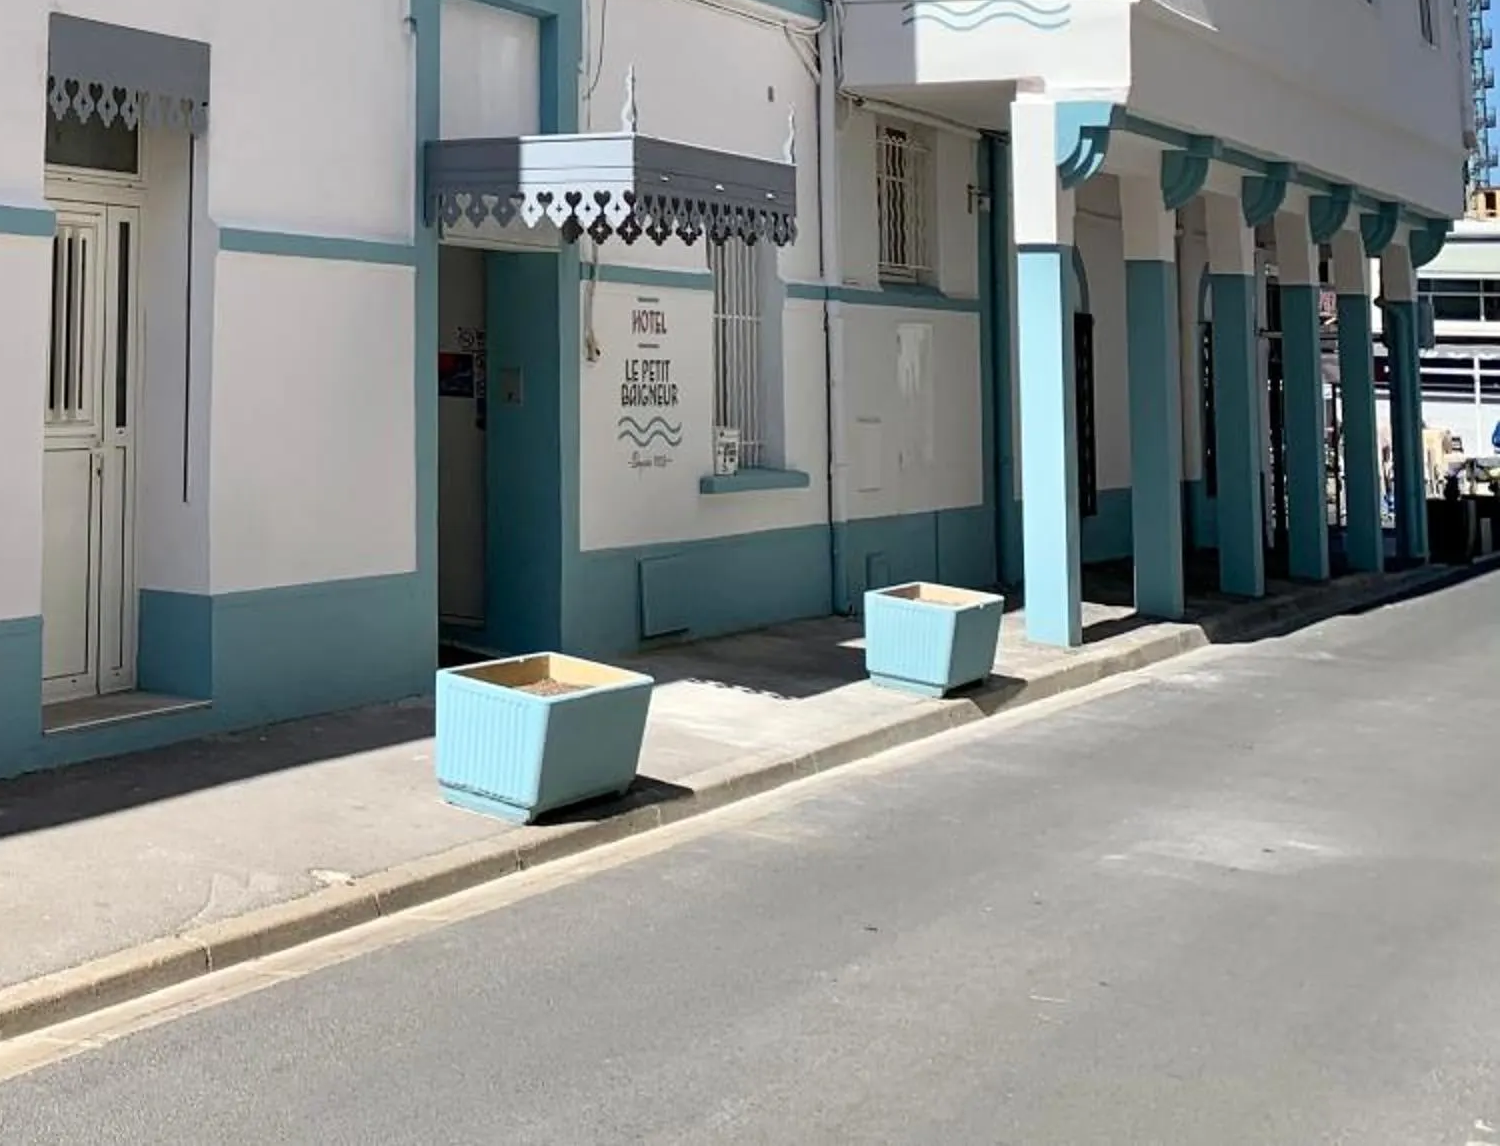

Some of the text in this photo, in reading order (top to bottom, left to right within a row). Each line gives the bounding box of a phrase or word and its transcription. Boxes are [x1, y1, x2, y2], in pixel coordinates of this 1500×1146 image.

[631, 310, 667, 334] HOTEL
[625, 359, 671, 383] LE PETIT
[621, 384, 679, 407] BAIGNEUR
